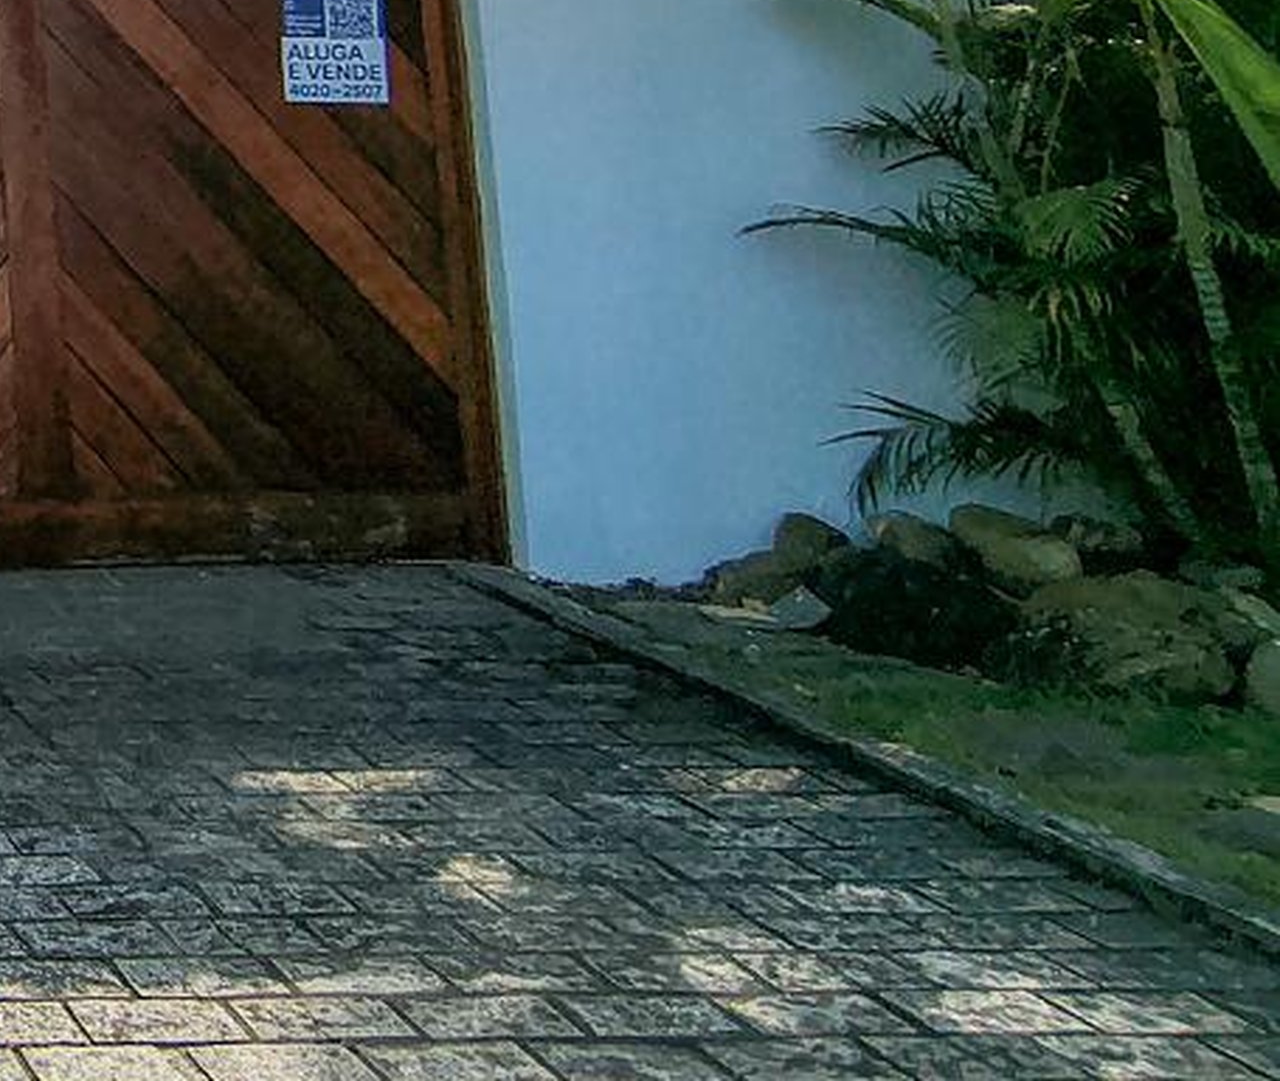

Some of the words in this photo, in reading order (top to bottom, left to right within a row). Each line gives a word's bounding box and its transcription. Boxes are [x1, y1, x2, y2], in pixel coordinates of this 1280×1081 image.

[288, 45, 363, 60] ALUGA
[289, 64, 301, 80] E
[306, 64, 382, 81] VENDE
